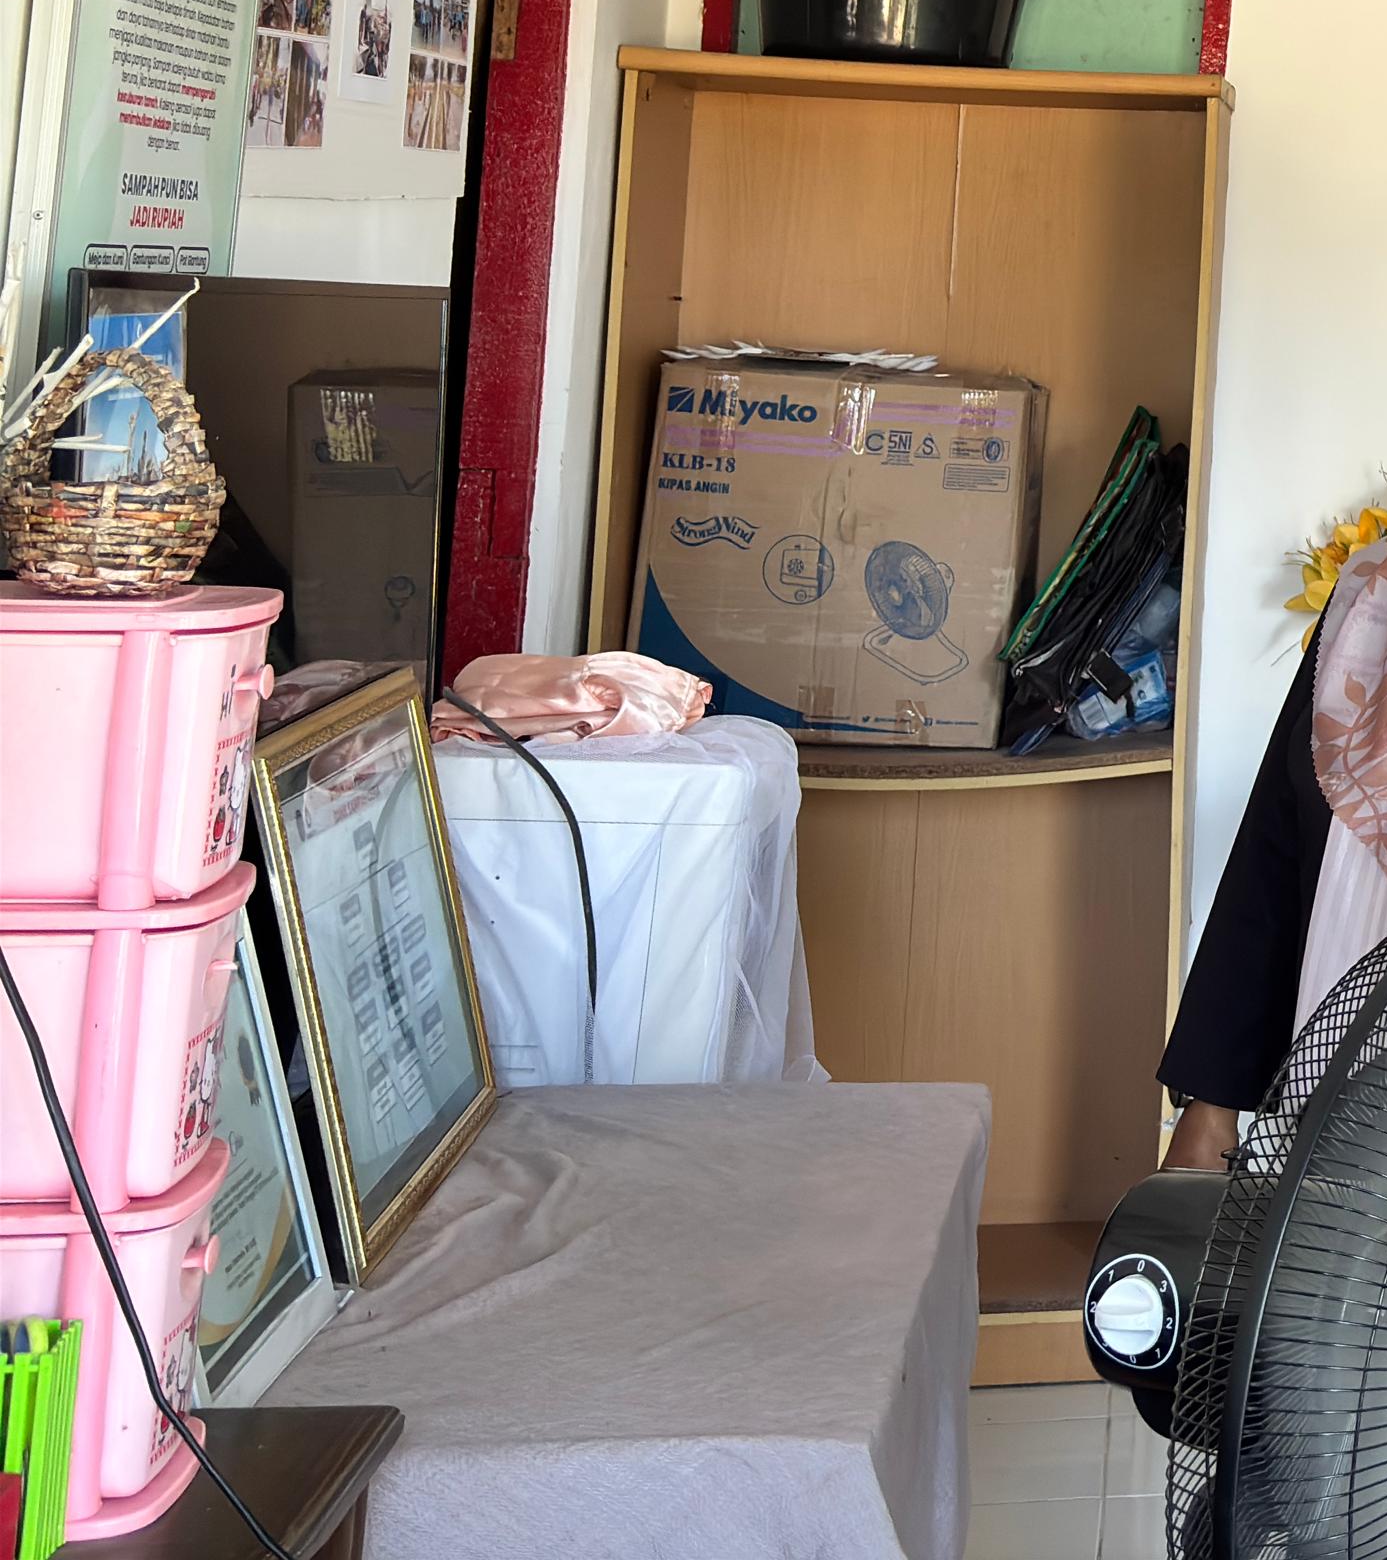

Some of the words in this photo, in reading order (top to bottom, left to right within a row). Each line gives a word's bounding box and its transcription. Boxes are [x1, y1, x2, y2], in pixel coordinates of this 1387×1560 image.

[122, 173, 160, 197] SAMPAH
[160, 177, 179, 199] PUN
[179, 179, 198, 200] BISA
[130, 205, 151, 227] JADI
[151, 207, 184, 229] RUPIAH
[662, 452, 736, 473] KLB-18
[659, 478, 692, 492] KIPAS
[694, 481, 730, 494] ANGIN
[722, 517, 755, 544] Wind
[1160, 1280, 1167, 1292] 3
[1166, 1317, 1173, 1329] 2
